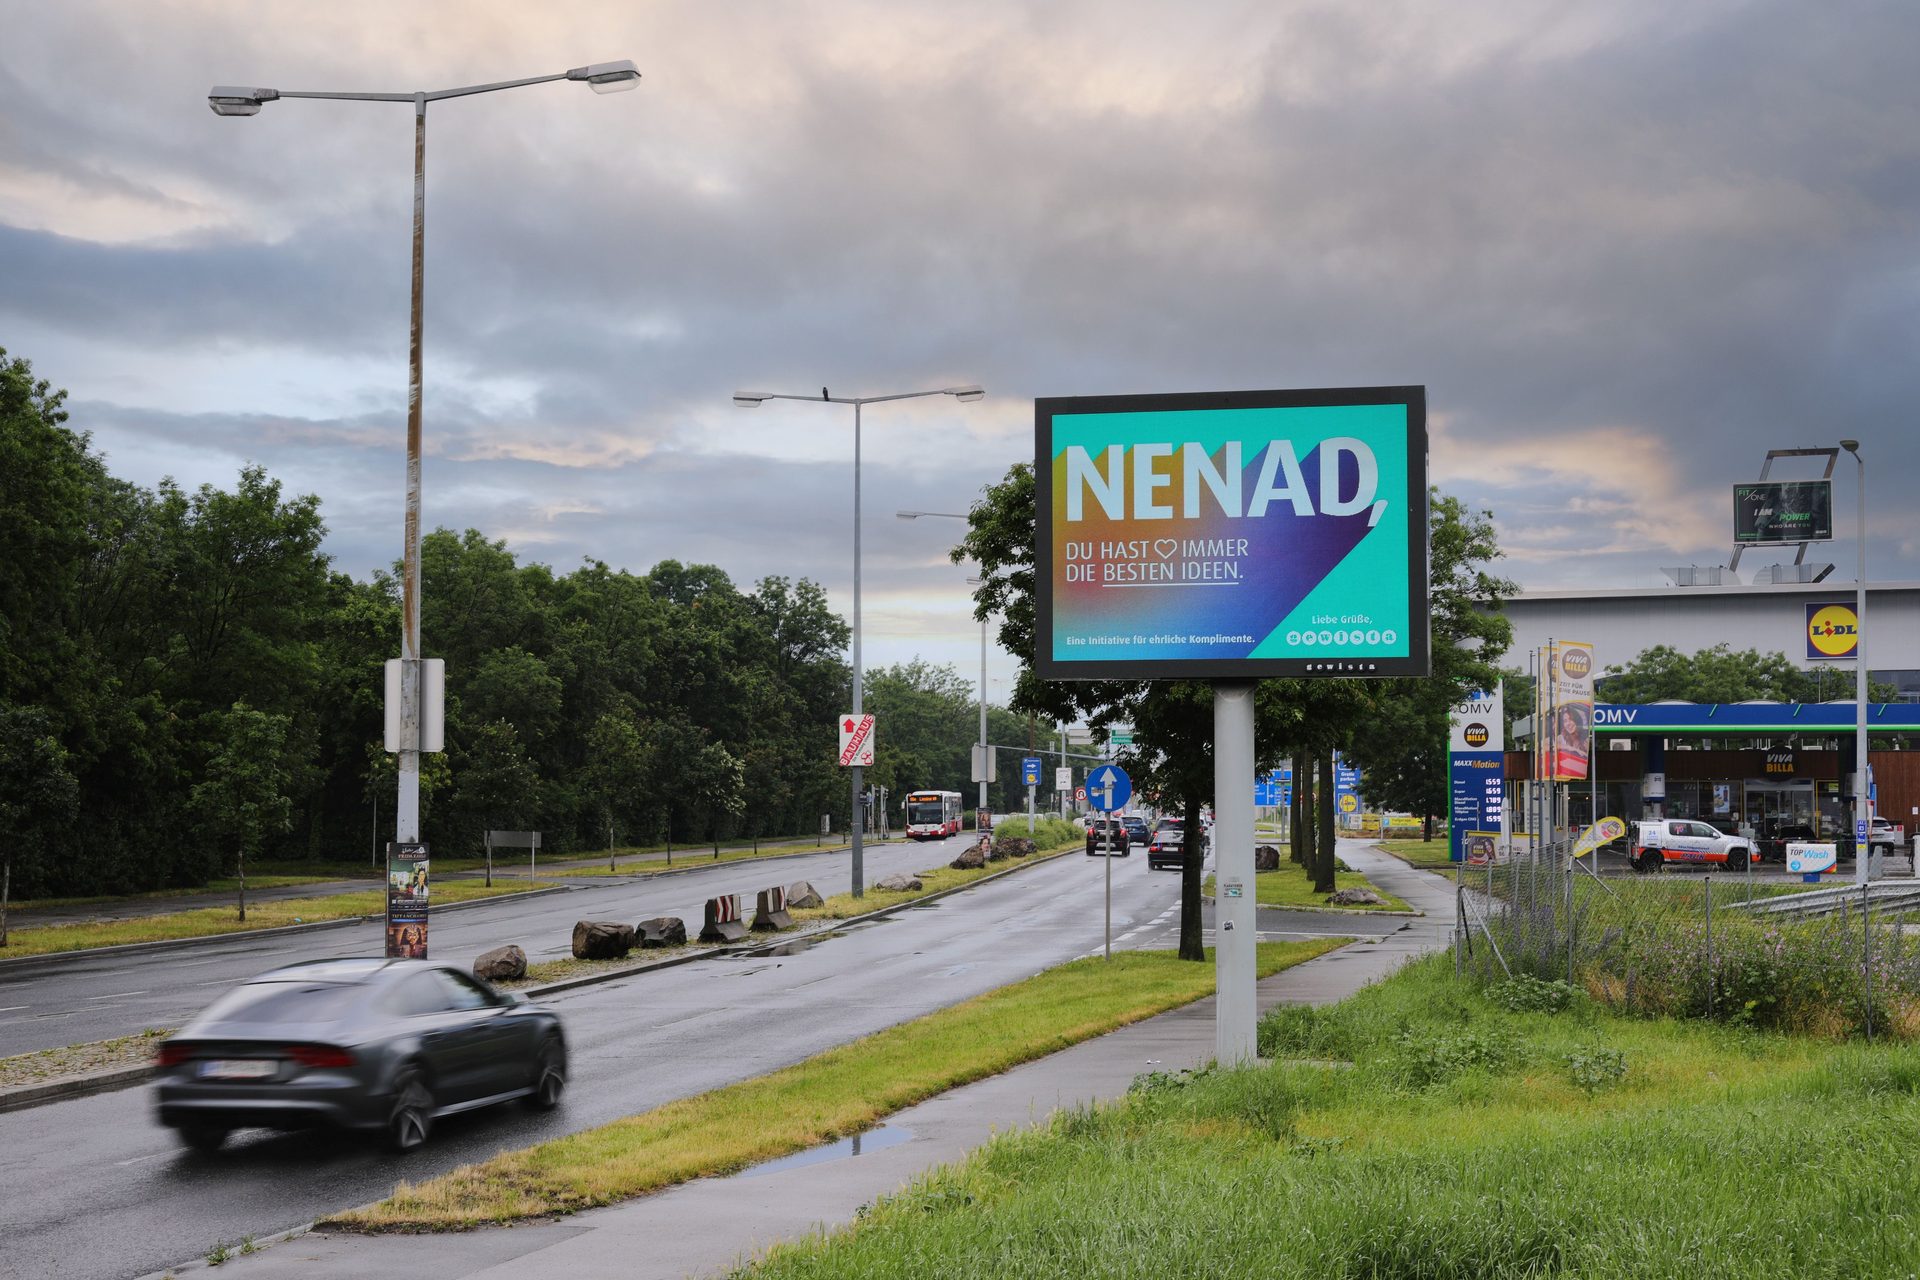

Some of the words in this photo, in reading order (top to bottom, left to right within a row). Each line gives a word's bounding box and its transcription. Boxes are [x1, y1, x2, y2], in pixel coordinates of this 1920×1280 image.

[1066, 437, 1388, 527] NENAD,
[1780, 513, 1810, 521] POWER
[1066, 542, 1092, 560] DU
[1101, 541, 1150, 560] HAST
[1182, 538, 1248, 557] IMMER
[1066, 564, 1096, 582] DIE
[1104, 562, 1174, 582] BESTEN
[1182, 561, 1244, 580] IDEEN.
[1312, 616, 1338, 624] Liebe
[1340, 614, 1373, 625] Grüße,
[1066, 636, 1086, 646] Eine
[1088, 636, 1130, 645] Initiative
[1133, 634, 1147, 644] für
[1149, 634, 1187, 644] ehrliche
[1190, 633, 1256, 645] Komplimente.
[1287, 631, 1396, 645] gewista
[1566, 654, 1588, 664] VIVA
[1306, 662, 1376, 671] gewista
[1565, 662, 1588, 672] BILLA
[1460, 704, 1492, 714] OMV
[1594, 709, 1638, 723] OMV
[840, 714, 873, 766] BAUHAUS
[1766, 754, 1793, 762] VIVA
[1766, 764, 1794, 772] BILLA
[1804, 849, 1828, 858] Wash
